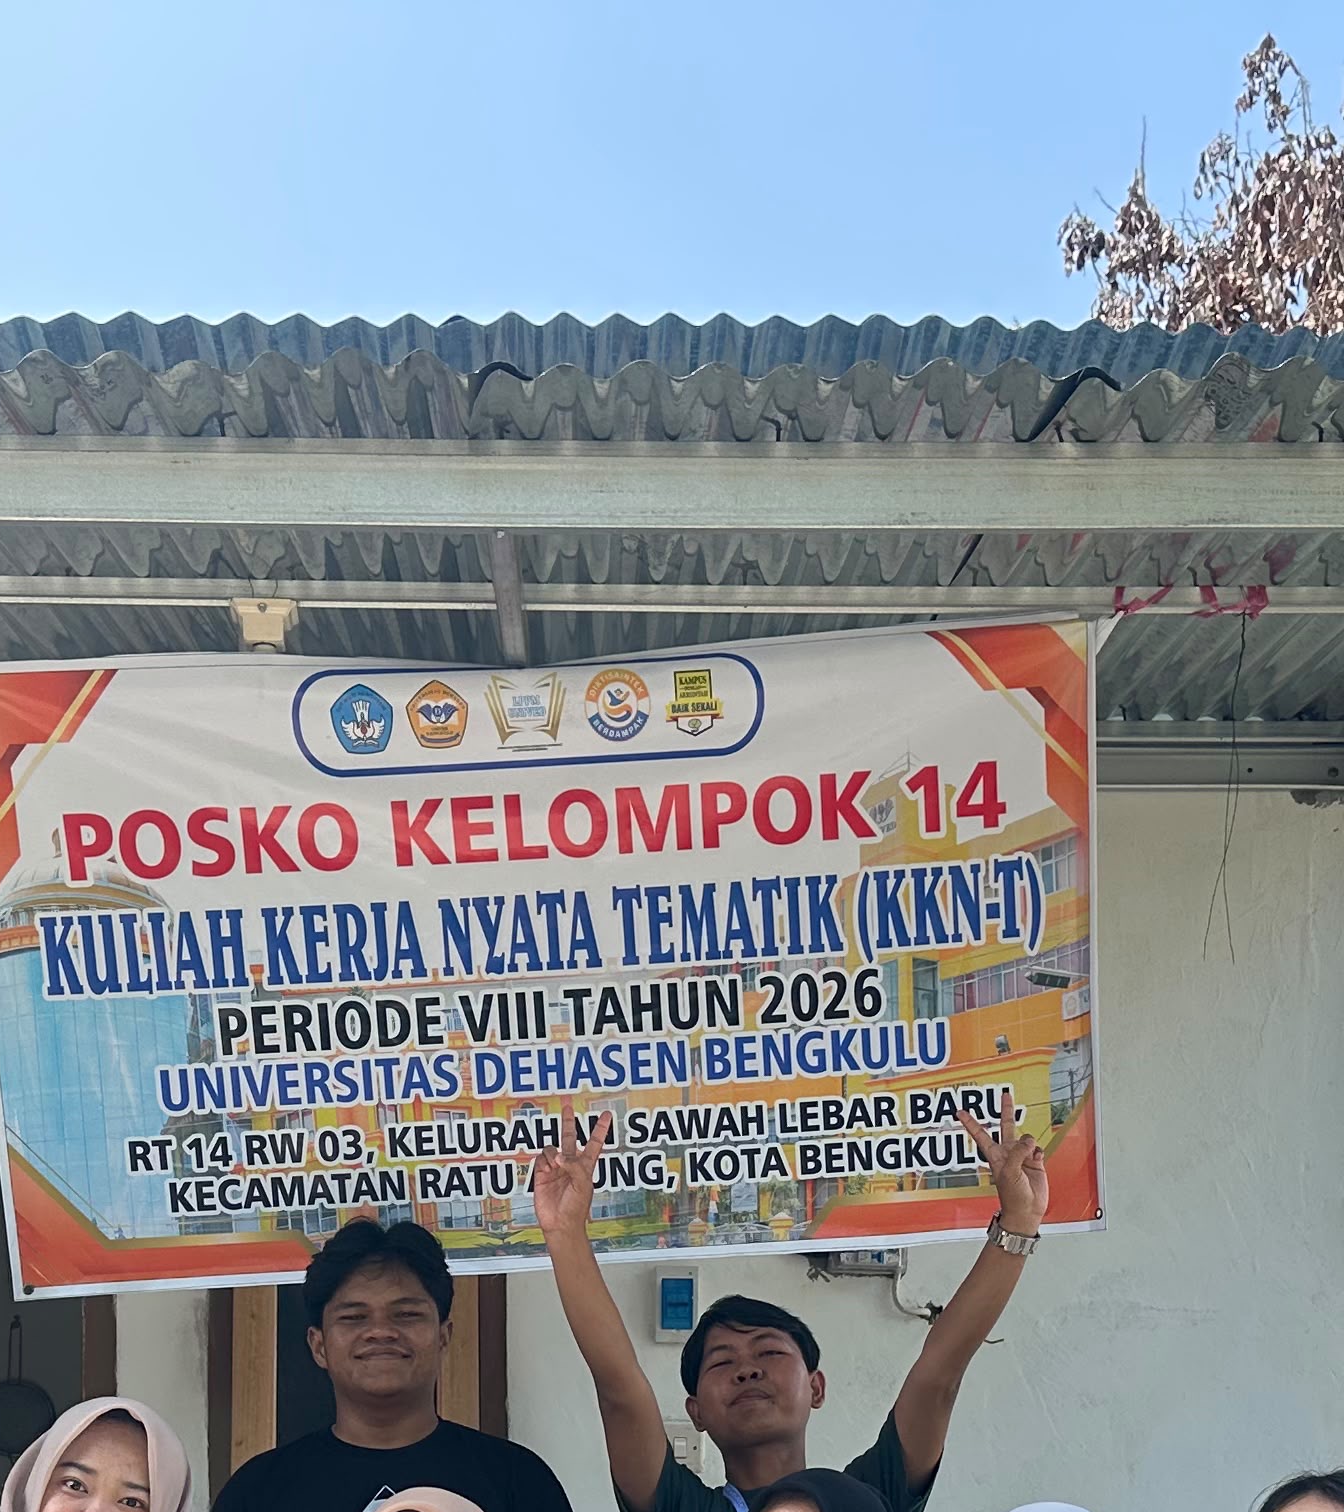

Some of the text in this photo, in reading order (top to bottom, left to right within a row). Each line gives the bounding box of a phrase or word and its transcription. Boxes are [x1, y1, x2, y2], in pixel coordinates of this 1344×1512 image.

[592, 716, 644, 738] BERDAMPAK
[691, 701, 718, 712] SEKALI
[62, 760, 1007, 881] POSKO KELOMPOK 14
[39, 857, 1042, 996] KULIAH KERJA NYATA TEMATIK (KKN-T)
[217, 968, 882, 1056] PERIODE VIII TAHUN 2026
[160, 1022, 946, 1112] UNIVERSITAS DEHASEN BENGKULU
[128, 1139, 173, 1172] RT
[187, 1136, 232, 1168] 14
[246, 1132, 305, 1166] RW
[318, 1130, 375, 1165] 03,
[628, 1104, 764, 1143] SAWAH
[779, 1095, 897, 1133] LEBAR
[168, 1170, 405, 1213] KECAMATAN
[420, 1163, 514, 1199] RATU
[689, 1144, 789, 1184] KOTA
